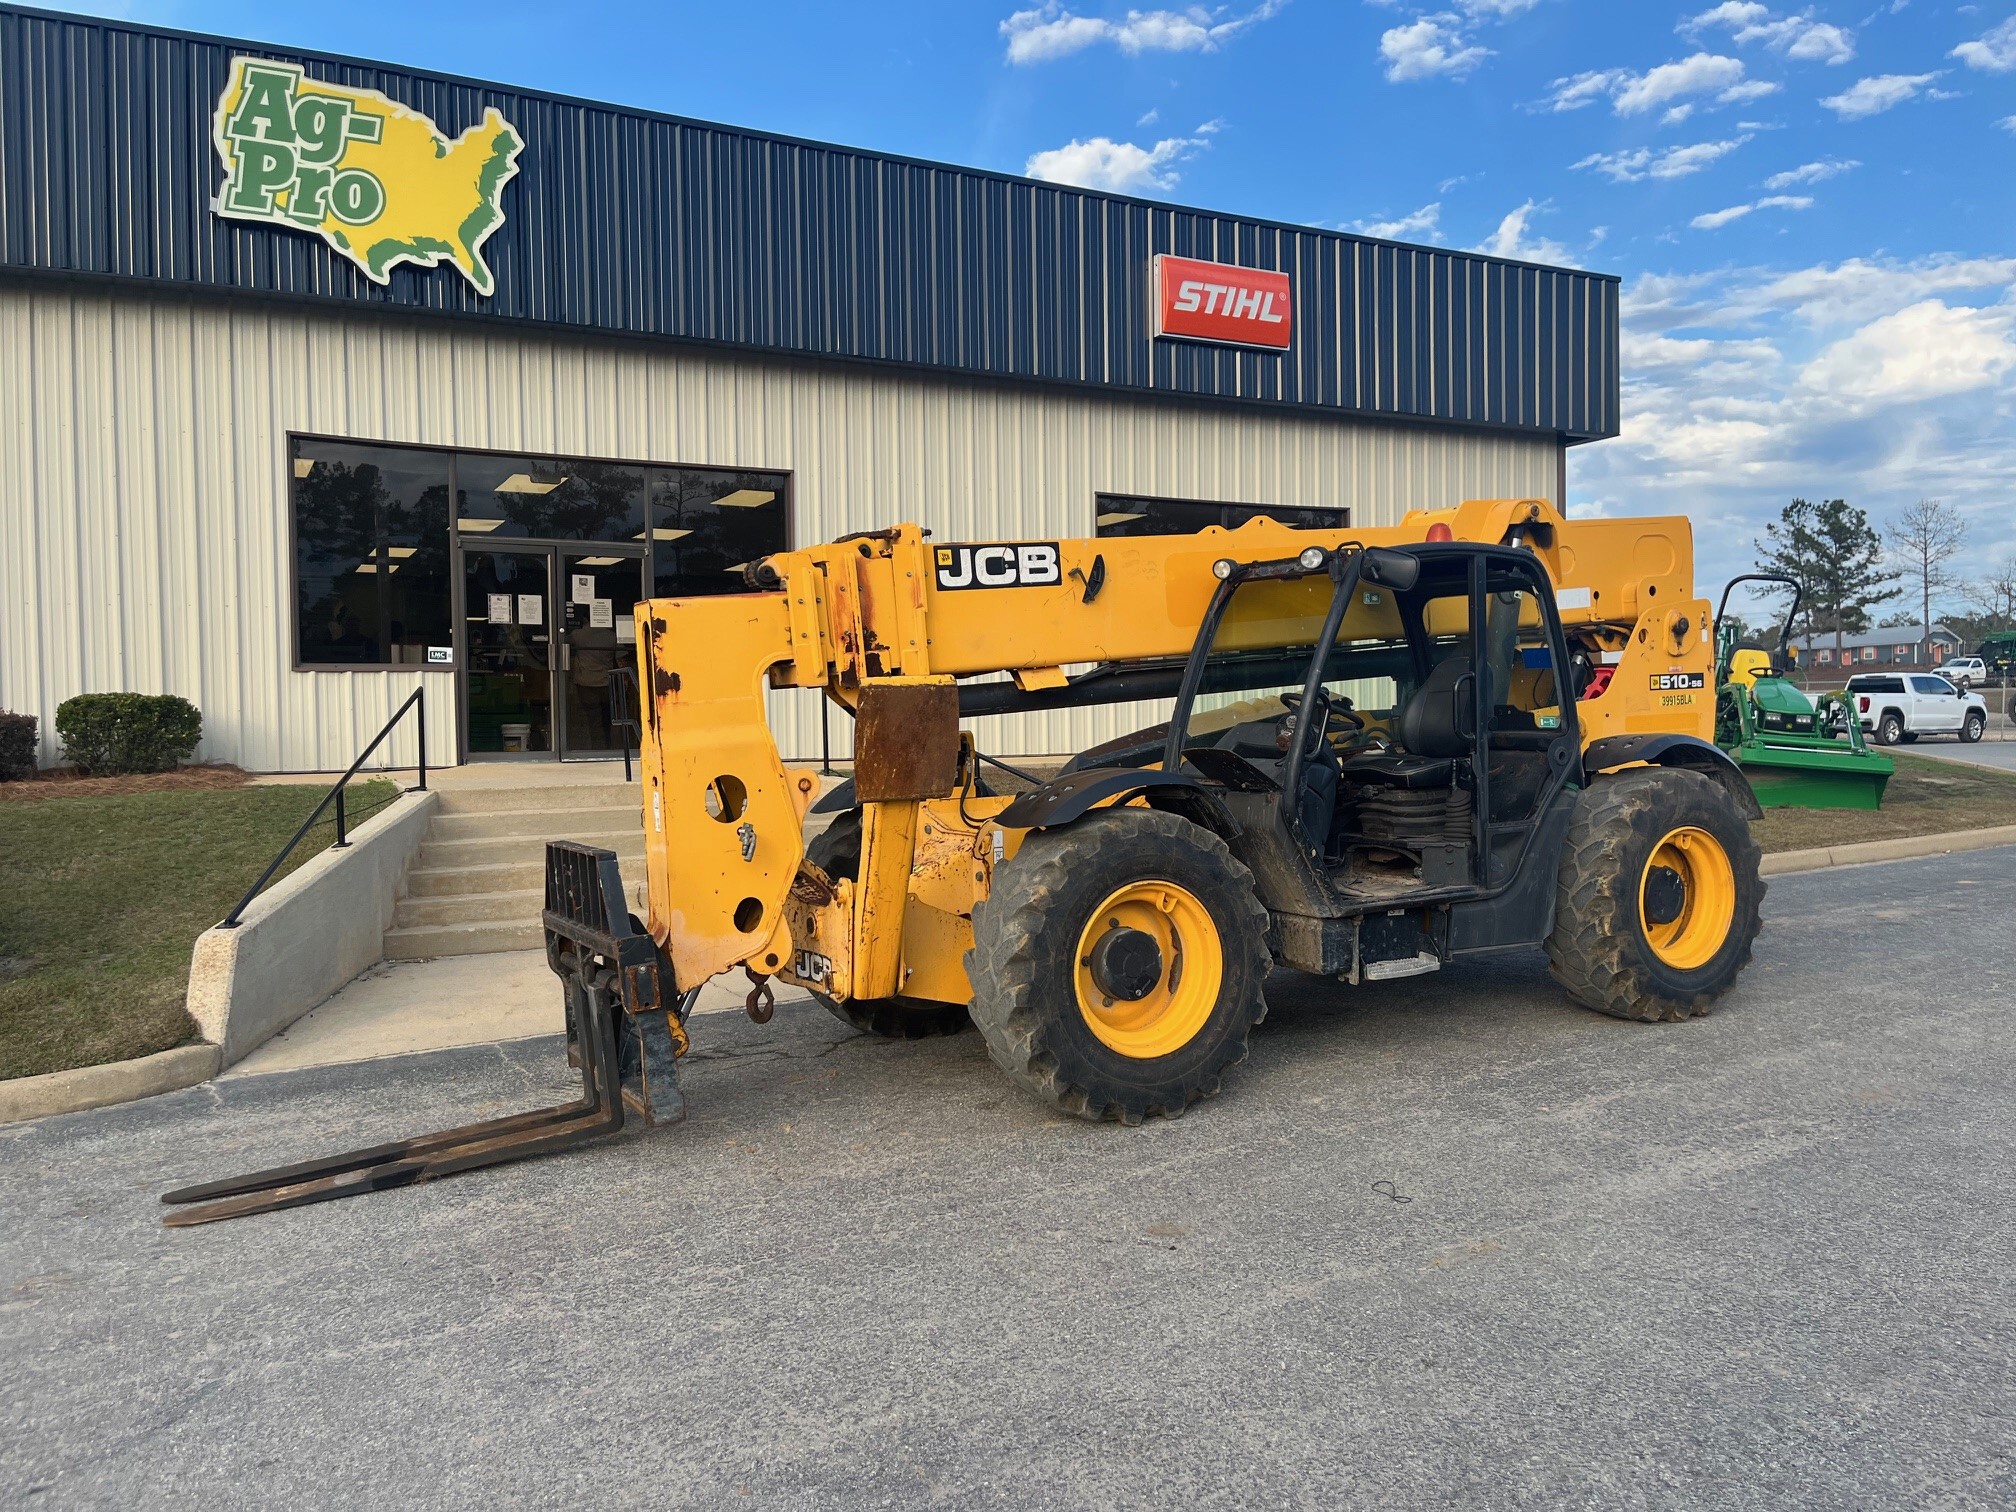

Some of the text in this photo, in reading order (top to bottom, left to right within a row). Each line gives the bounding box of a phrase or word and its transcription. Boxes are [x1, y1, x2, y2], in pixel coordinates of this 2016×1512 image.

[226, 63, 384, 165] Ag-
[227, 138, 386, 225] Pro
[1173, 280, 1283, 323] STIHL
[938, 546, 1058, 587] JCB
